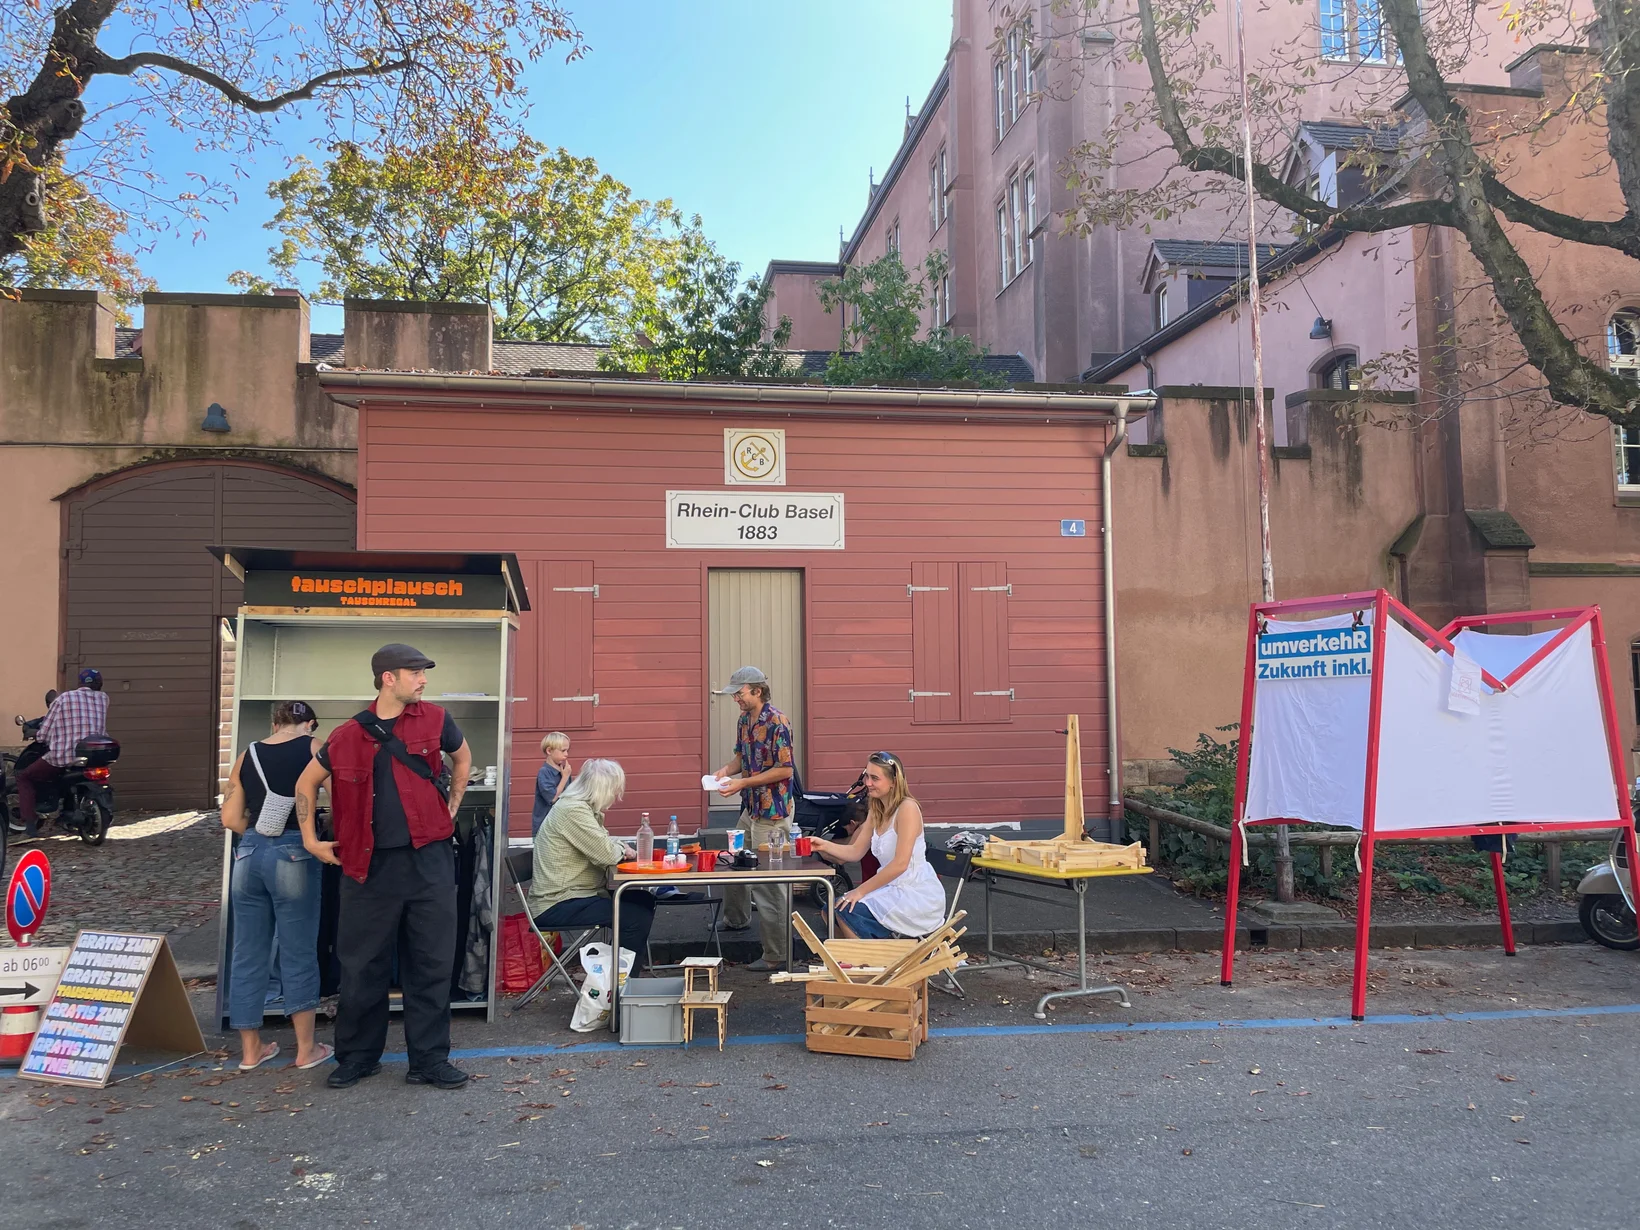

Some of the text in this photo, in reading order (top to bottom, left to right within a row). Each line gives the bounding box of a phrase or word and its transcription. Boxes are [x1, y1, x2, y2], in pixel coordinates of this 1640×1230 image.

[677, 503, 835, 520] Rhein-Club Basel
[737, 525, 778, 540] 1883
[1069, 522, 1077, 534] 4
[291, 575, 463, 597] tauschplausch
[340, 596, 417, 607] TAUSCHREGAL
[1261, 630, 1367, 656] umverkehR
[1258, 657, 1372, 680] Zukunft inkl.
[77, 934, 158, 954] GRATIS ZUM
[3, 958, 18, 972] ab
[69, 950, 152, 971] MITNEHMEN
[63, 967, 143, 988] GRATIS ZUM
[56, 984, 135, 1004] TAUSCHREGAL
[47, 1001, 129, 1024] GRATIS ZUM
[41, 1018, 123, 1042] MITNEHMEN
[32, 1037, 115, 1060] GRATIS ZUM
[25, 1054, 108, 1079] MITNEHMEN
